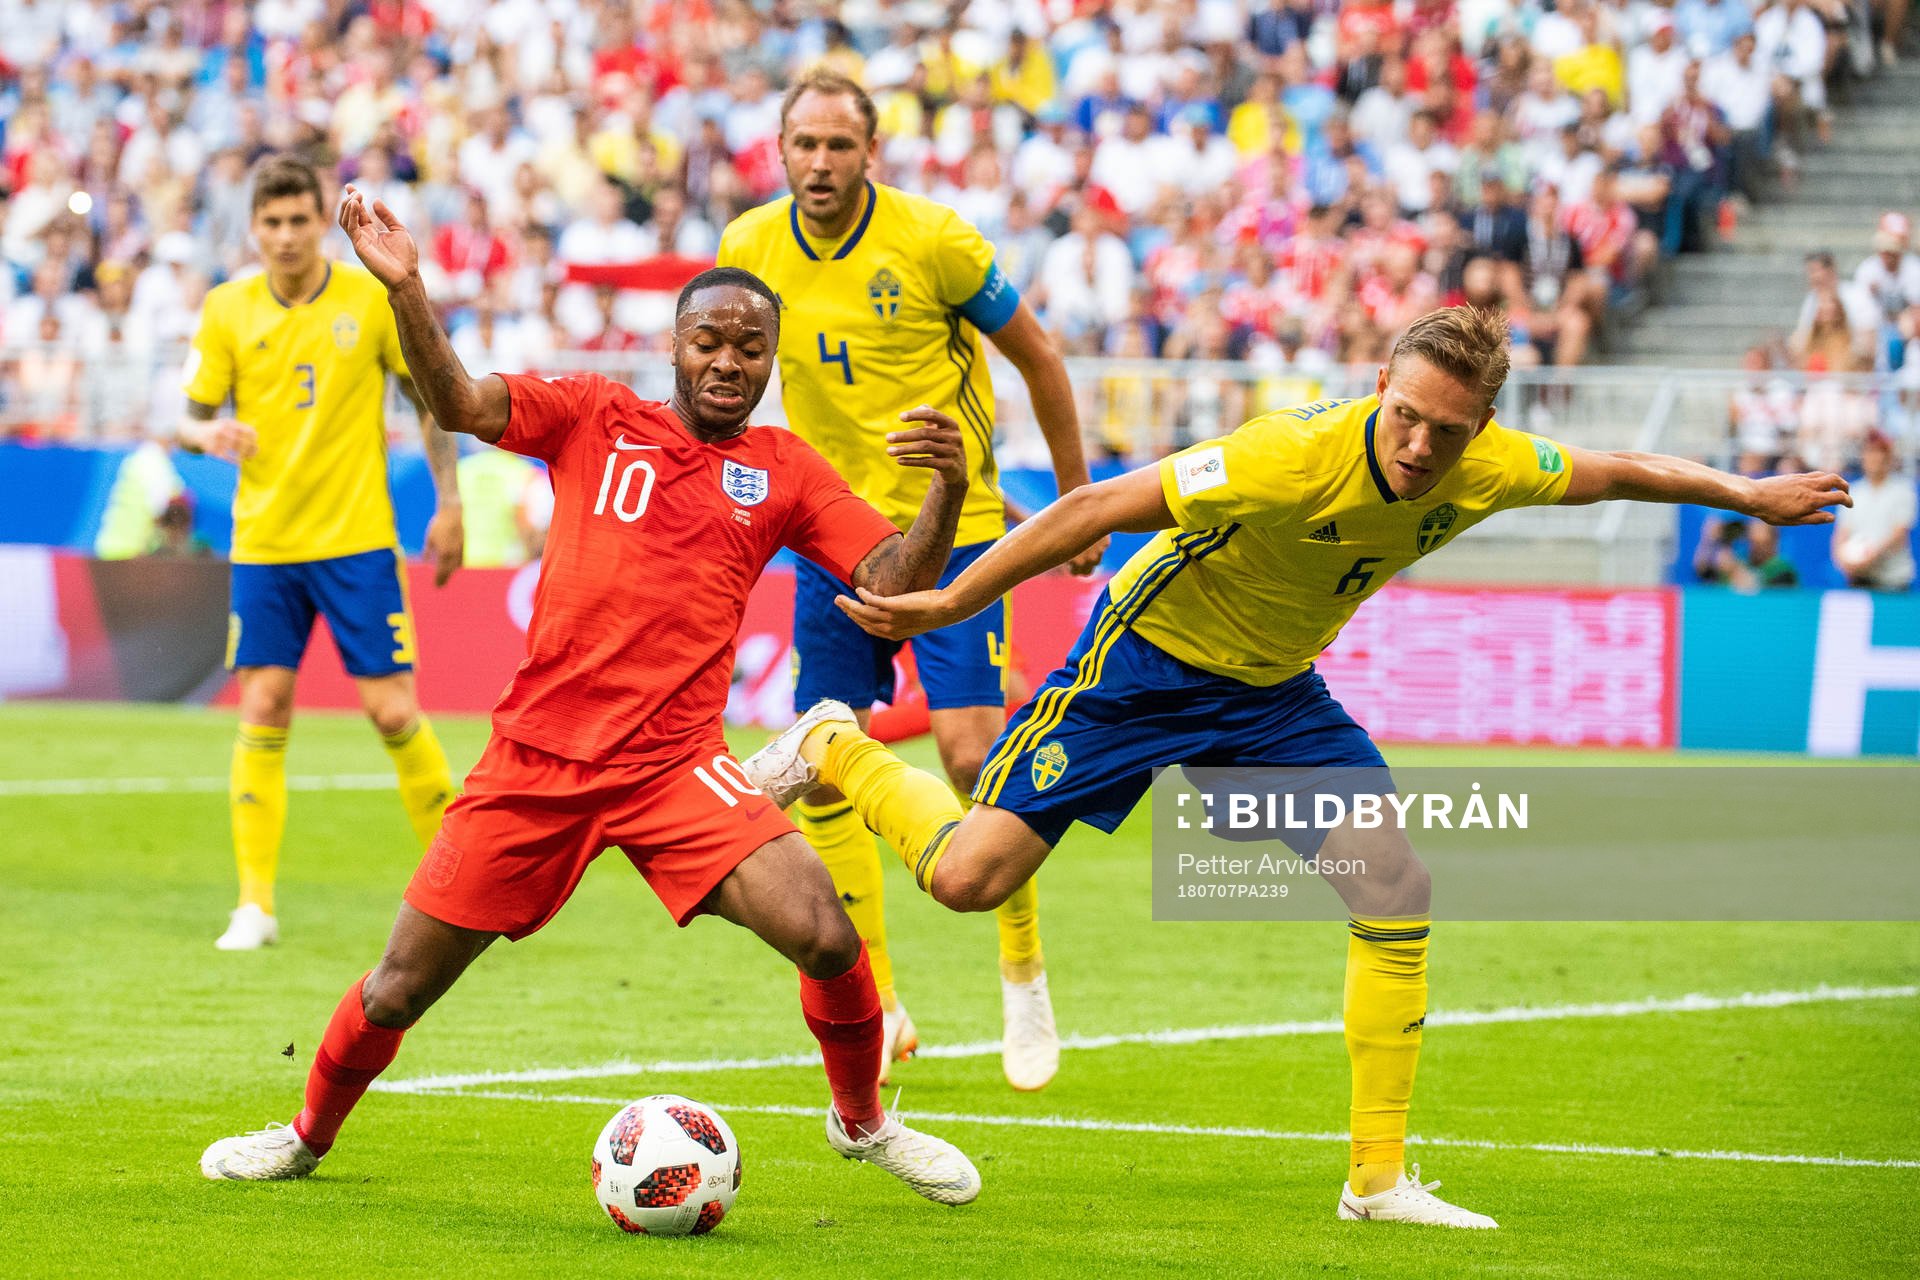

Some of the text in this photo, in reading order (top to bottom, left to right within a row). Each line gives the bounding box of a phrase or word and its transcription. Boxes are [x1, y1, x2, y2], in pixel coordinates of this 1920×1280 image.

[817, 332, 854, 386] 4
[295, 363, 315, 410] 3
[593, 451, 656, 523] 10
[1308, 533, 1341, 544] adidas
[1333, 557, 1387, 596] 6
[386, 612, 416, 665] 3
[693, 755, 763, 808] 10
